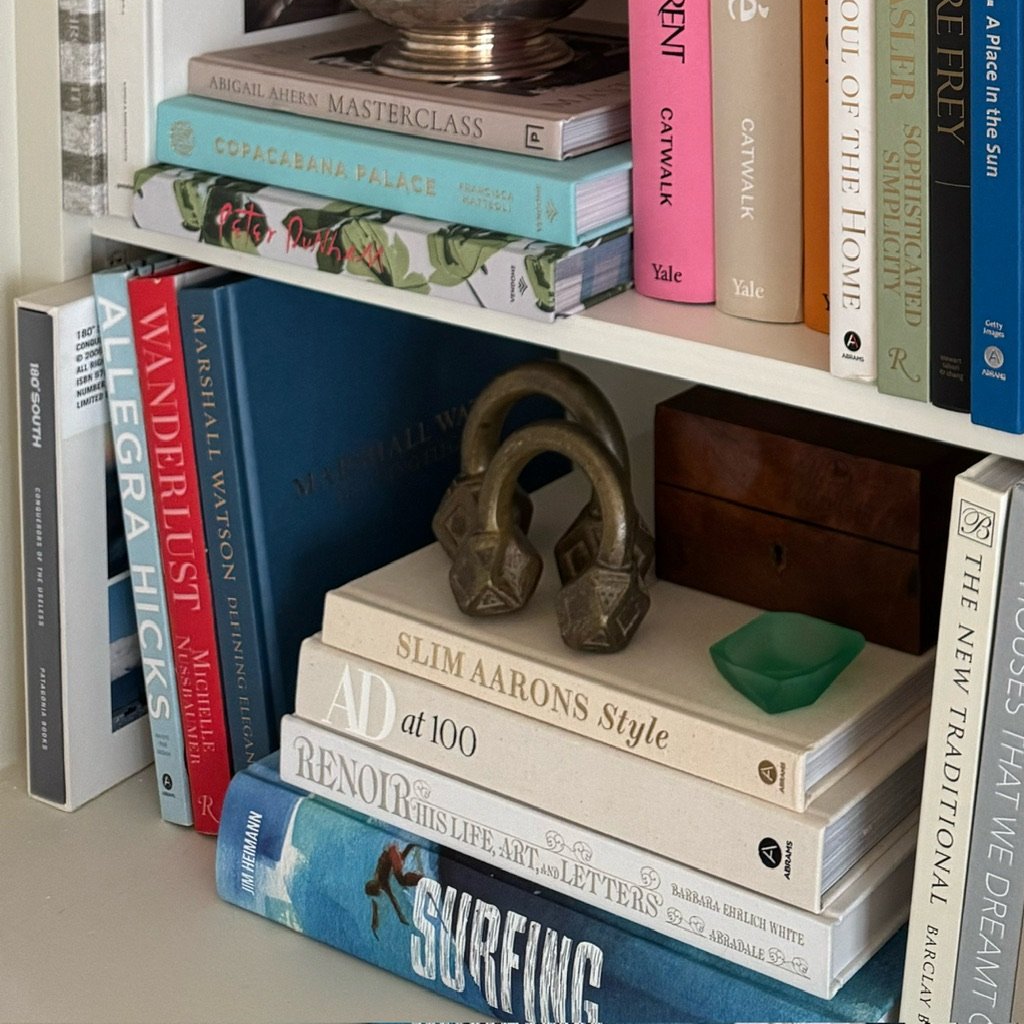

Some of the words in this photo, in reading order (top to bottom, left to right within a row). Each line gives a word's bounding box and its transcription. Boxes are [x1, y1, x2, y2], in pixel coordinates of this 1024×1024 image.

[985, 15, 1000, 29] A
[985, 33, 1001, 86] Place
[985, 87, 1001, 104] In
[208, 76, 265, 98] ABIGAIL
[269, 86, 319, 107] AHERN
[327, 93, 484, 139] MASTERCLASS
[840, 74, 861, 119] OF
[935, 47, 966, 146] FREY
[985, 104, 1002, 139] the
[213, 136, 347, 178] COPACABANA
[355, 163, 437, 197] PALACE
[659, 107, 674, 207] CATWALK
[740, 118, 755, 221] CATWALK
[841, 128, 861, 195] THE
[985, 140, 1002, 178] Sun
[841, 207, 867, 311] HOME
[882, 149, 901, 297] SIMPLICITY
[903, 123, 923, 329] SOPHISTICATED
[651, 262, 683, 283] Yale
[731, 278, 765, 299] Yale
[139, 305, 201, 612] WANDERLUST
[191, 313, 221, 461] MARSHALL
[210, 470, 237, 582] WATSON
[97, 296, 151, 541] ALLEGRA
[131, 564, 170, 721] HICKS
[960, 554, 983, 612] THE
[396, 631, 466, 679] SLIM
[470, 658, 590, 721] AARONS
[597, 702, 670, 750] Style
[953, 622, 976, 695] NEW
[321, 662, 397, 742] AD
[401, 711, 427, 738] at
[430, 714, 478, 758] 100
[241, 810, 263, 873] HEIMANN
[293, 735, 413, 822] RENOIR
[559, 858, 665, 919] LETTERS
[930, 707, 968, 905] TRADITIONAL
[986, 816, 1017, 867] WE
[240, 872, 255, 897] JIM
[783, 839, 794, 881] ABRAMS
[410, 877, 604, 1023] SURFING
[917, 923, 939, 1009] BARCLAY
[971, 871, 1010, 1009] DREAMT
